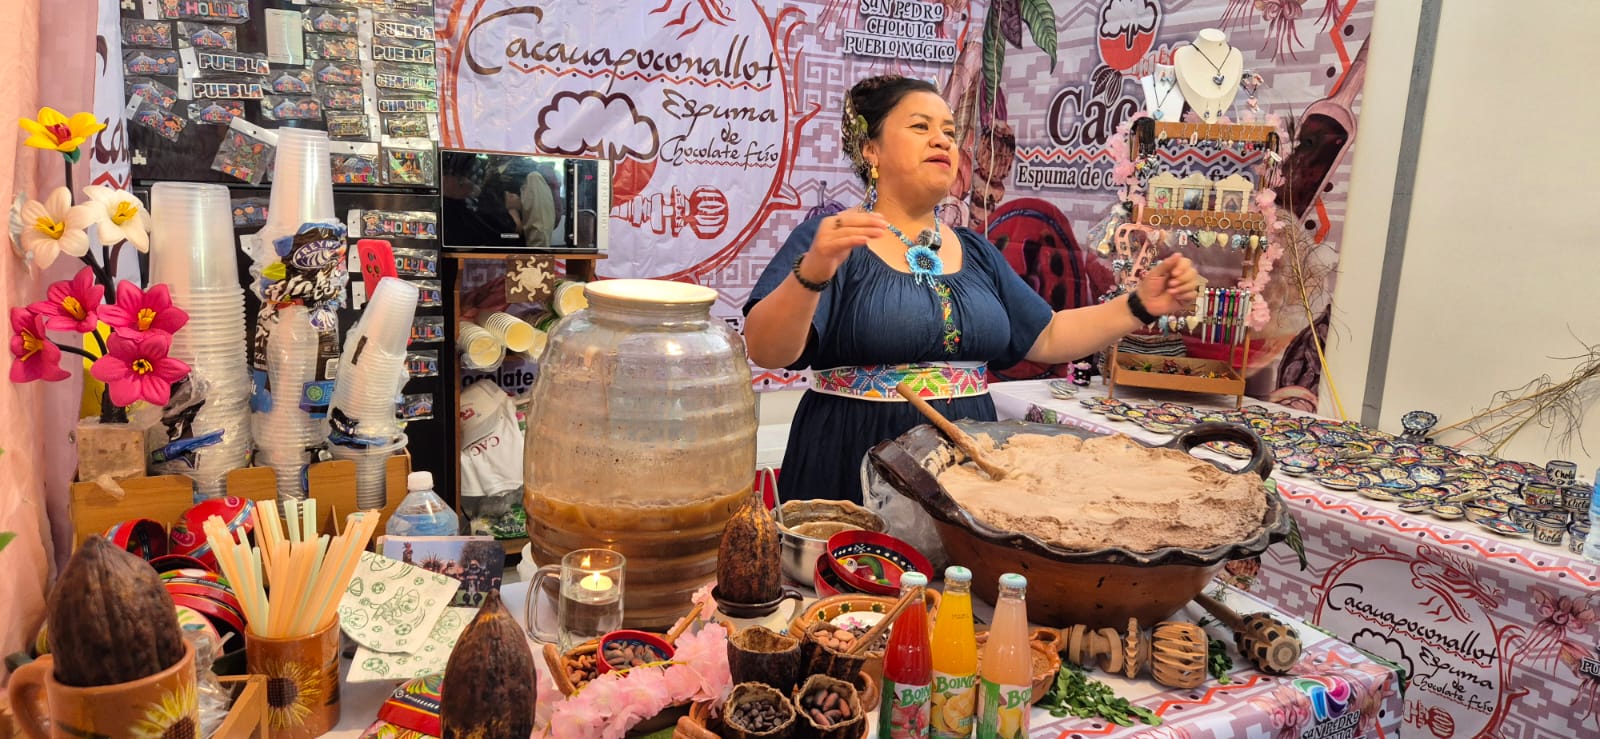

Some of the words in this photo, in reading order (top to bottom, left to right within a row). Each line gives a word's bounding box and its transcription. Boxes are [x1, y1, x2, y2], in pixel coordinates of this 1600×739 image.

[199, 53, 270, 75] PUEBLA
[192, 82, 264, 99] PUEBLA
[662, 88, 778, 137] Espuma
[720, 121, 742, 145] de
[660, 134, 741, 167] Chocolate
[1017, 164, 1076, 188] Espuma
[1080, 166, 1100, 187] de
[1419, 646, 1494, 690] Espuma
[901, 686, 931, 707] BOIN
[1413, 673, 1465, 702] Chocolate
[1452, 678, 1466, 693] de
